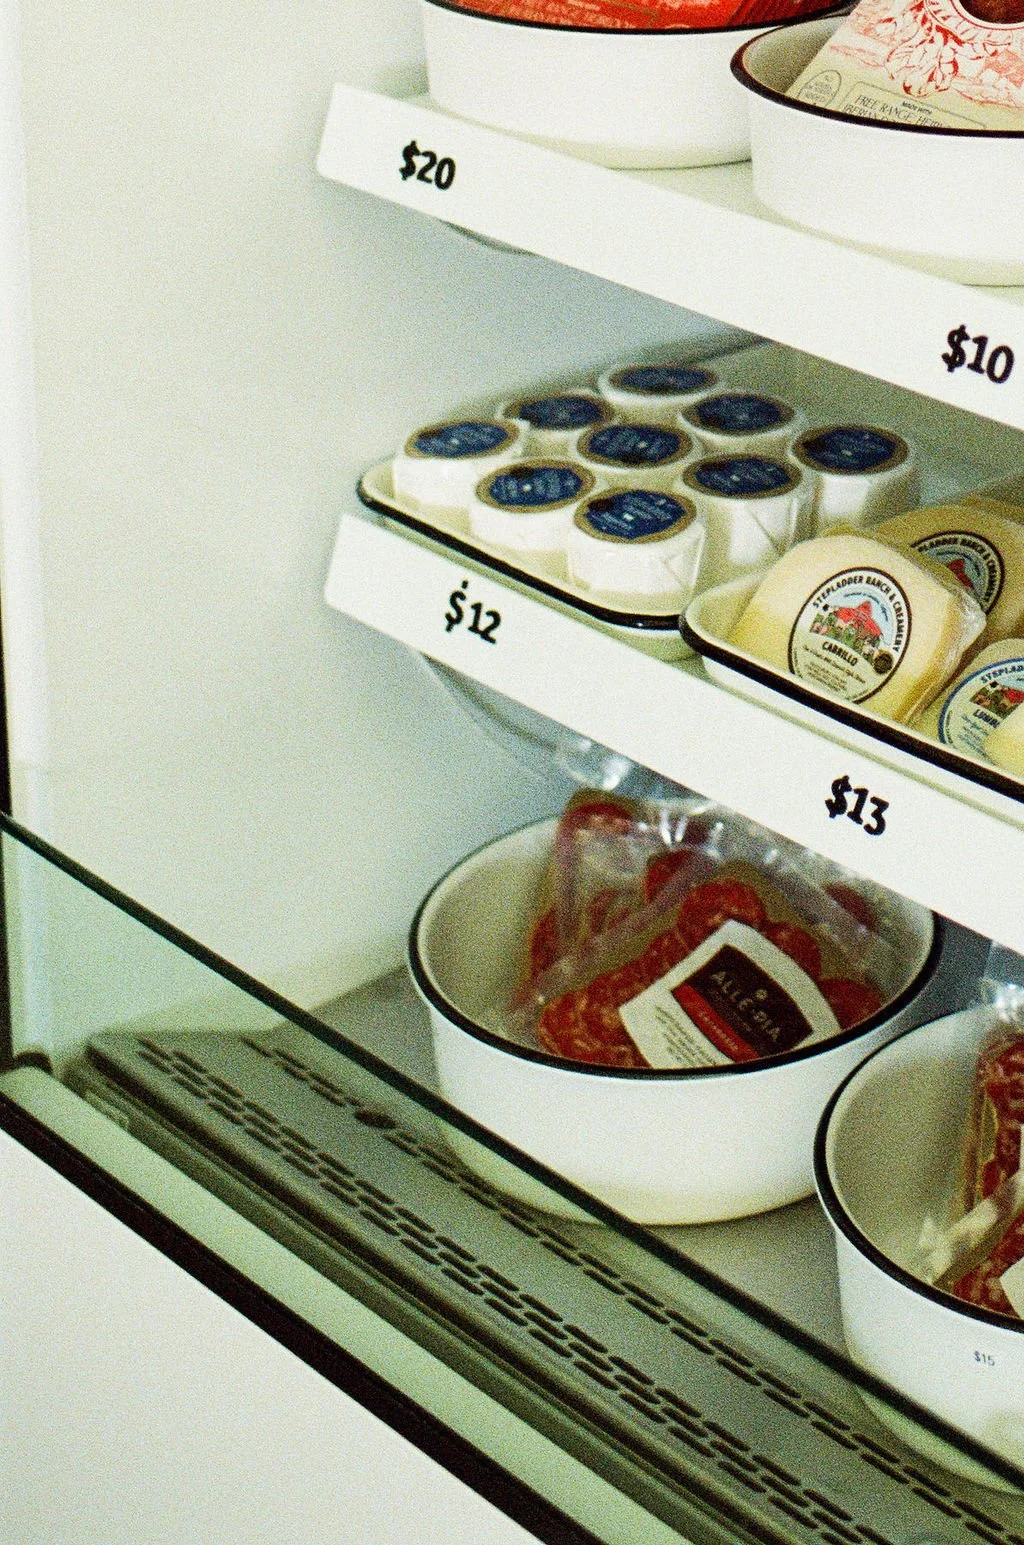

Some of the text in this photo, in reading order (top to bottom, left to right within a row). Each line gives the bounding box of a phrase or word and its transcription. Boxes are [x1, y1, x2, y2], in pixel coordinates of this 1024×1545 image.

[399, 140, 456, 190] $20
[941, 324, 1015, 384] $10
[917, 537, 959, 555] PLADDER
[445, 580, 501, 632] $12
[812, 575, 863, 608] STEPLADDER
[865, 576, 891, 596] RANCH
[824, 775, 889, 836] $13
